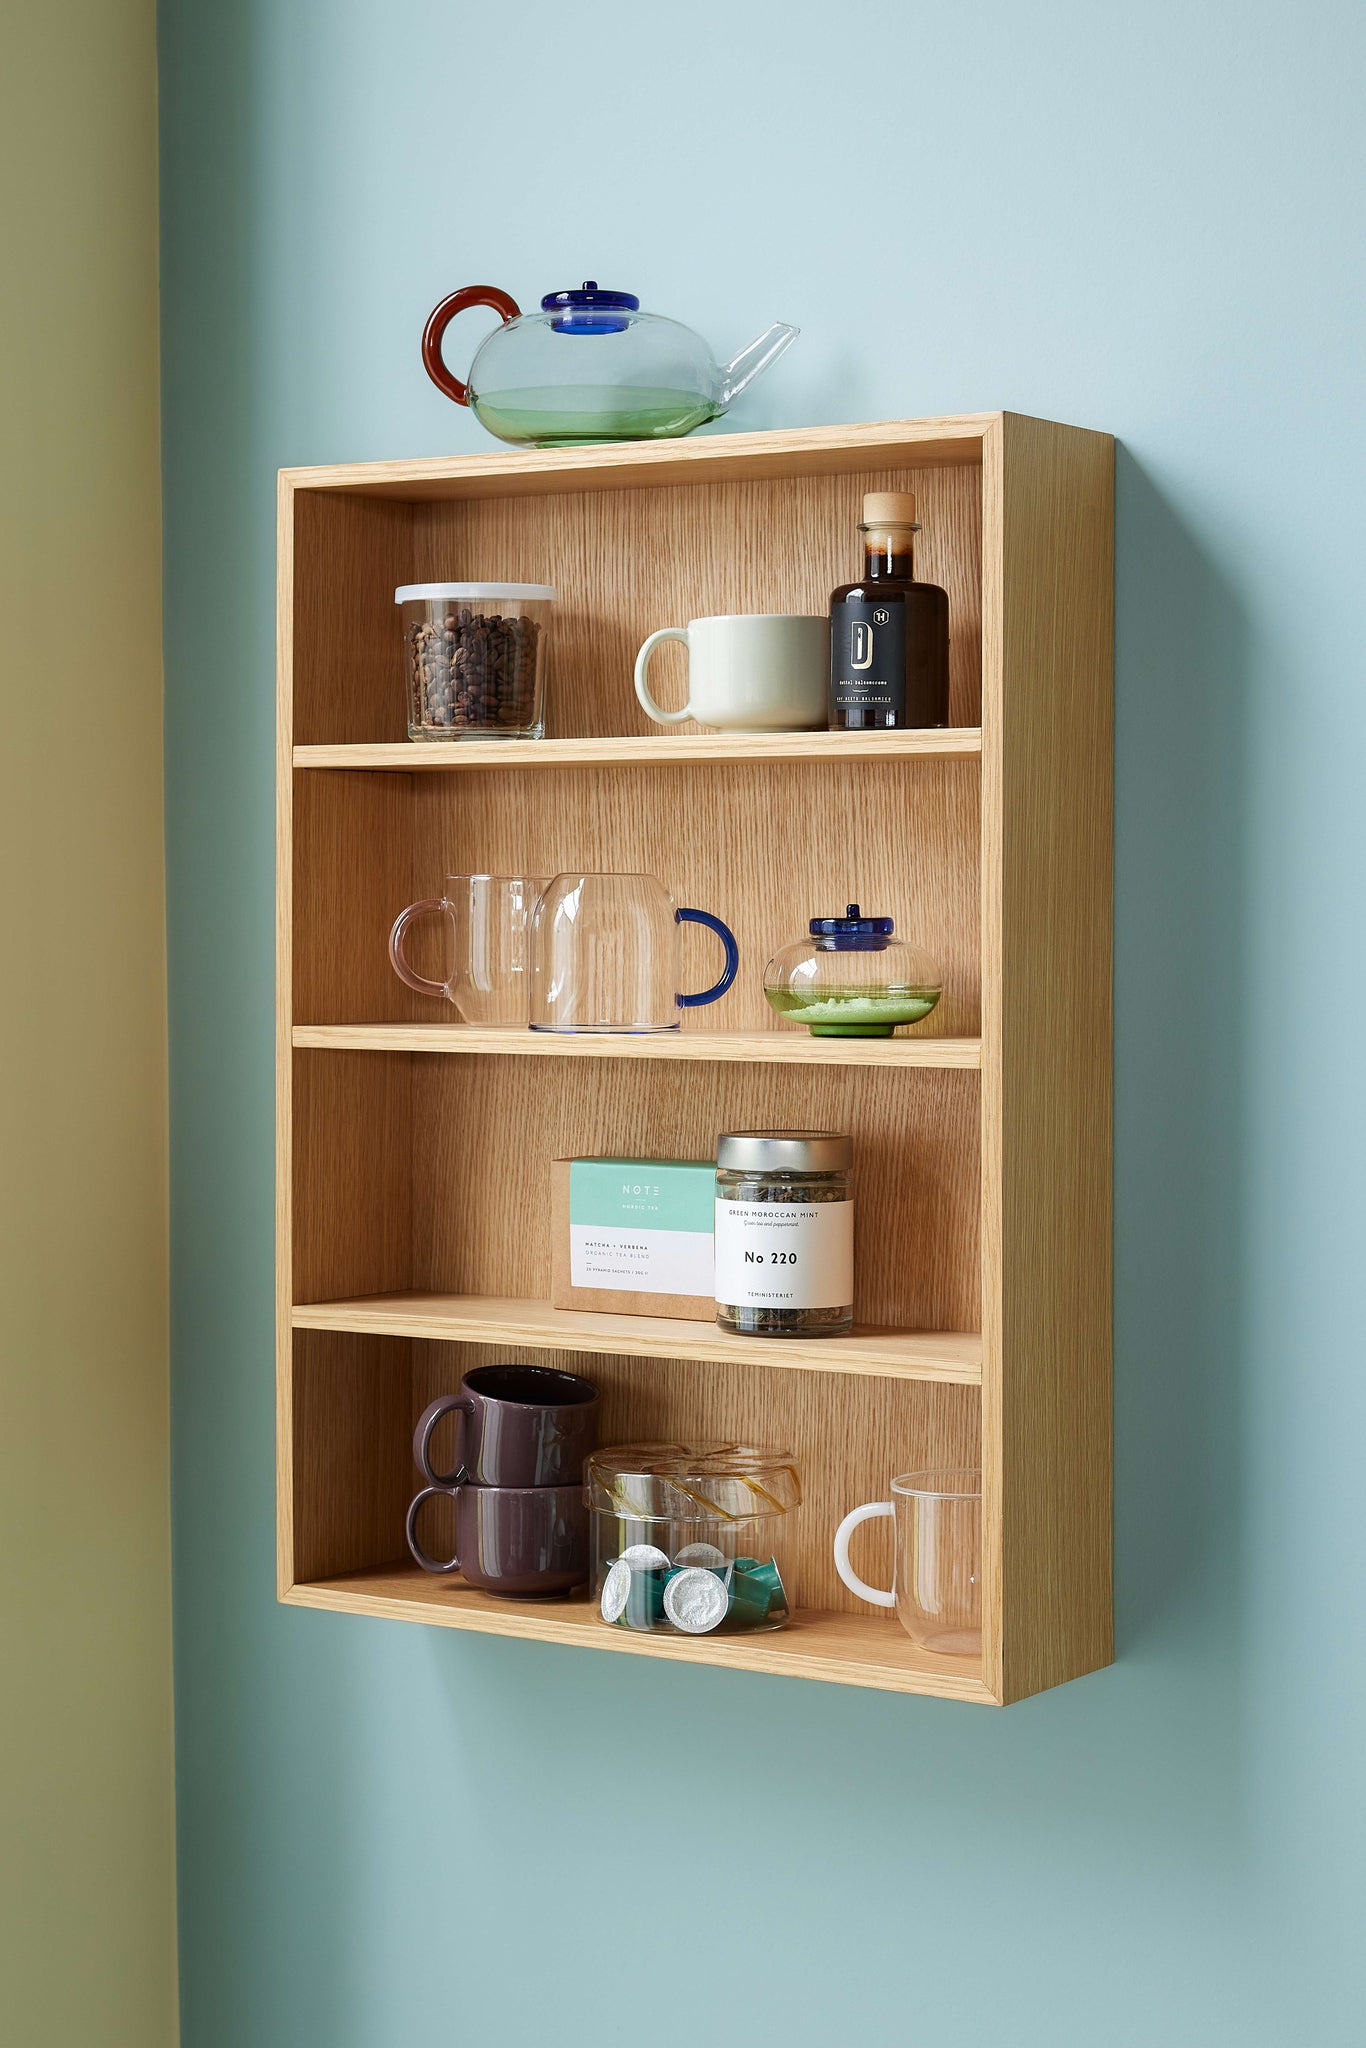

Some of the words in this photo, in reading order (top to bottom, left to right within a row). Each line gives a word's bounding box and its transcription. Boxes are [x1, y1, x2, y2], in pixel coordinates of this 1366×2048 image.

[851, 621, 873, 669] D
[622, 1185, 659, 1195] NOTE
[745, 1251, 764, 1264] No
[771, 1253, 797, 1265] 220
